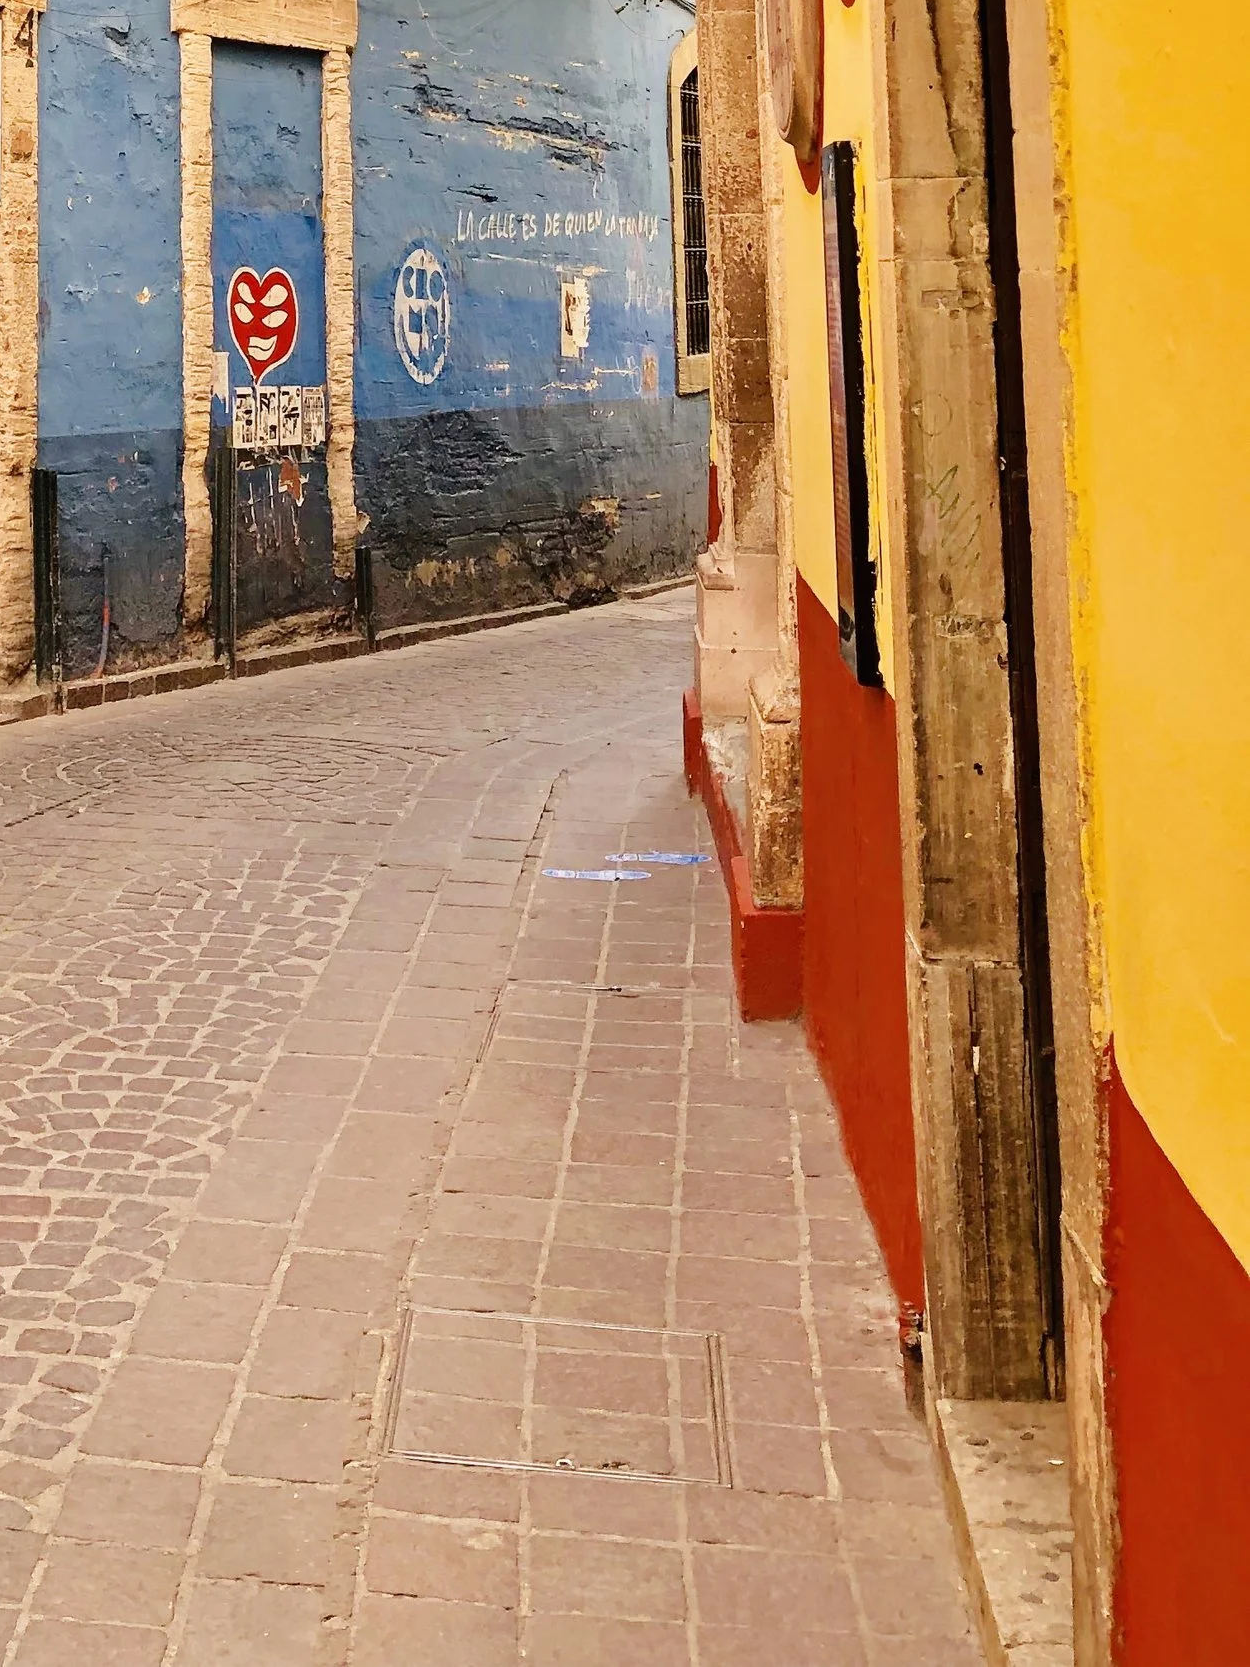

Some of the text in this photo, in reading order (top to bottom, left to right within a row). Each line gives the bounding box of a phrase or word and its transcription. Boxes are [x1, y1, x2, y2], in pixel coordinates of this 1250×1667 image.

[456, 209, 475, 242] LA
[478, 212, 517, 241] CALLE
[521, 212, 538, 241] ES
[543, 211, 561, 237] DE
[564, 207, 603, 239] QUIEN
